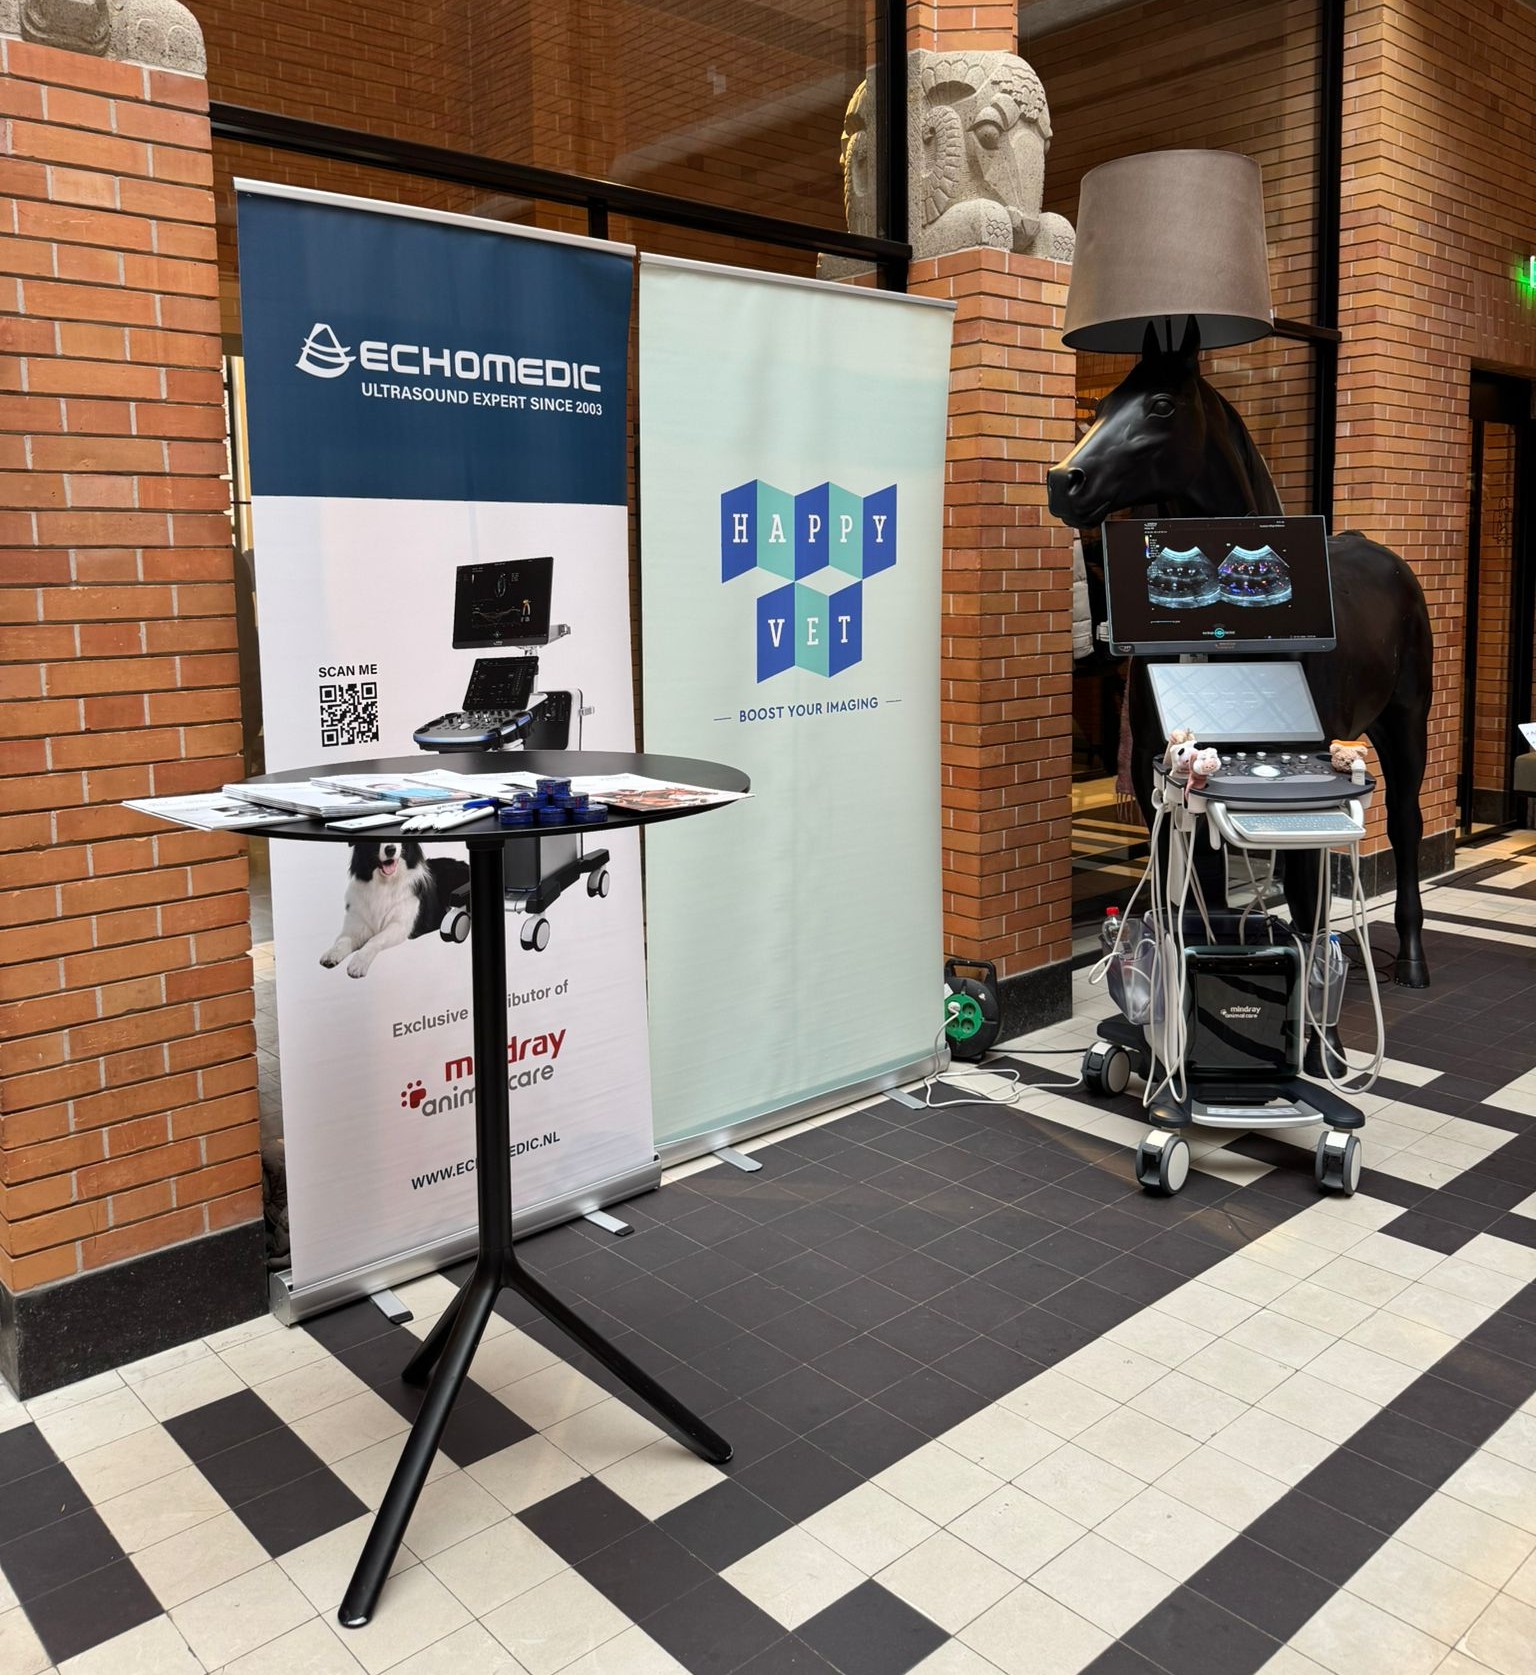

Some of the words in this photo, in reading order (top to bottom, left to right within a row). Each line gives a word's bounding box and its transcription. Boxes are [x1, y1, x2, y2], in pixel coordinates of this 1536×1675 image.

[360, 341, 602, 393] ECHOMEDIC
[361, 382, 469, 405] ULTRASOUND
[473, 392, 527, 409] EXPERT
[530, 397, 573, 413] SINCE
[576, 401, 602, 415] 2003
[733, 513, 887, 543] HAPPY
[768, 615, 850, 647] VET
[318, 665, 355, 678] SCAN
[359, 663, 378, 676] ME
[739, 706, 784, 722] BOOST
[788, 702, 823, 717] YOUR
[826, 697, 879, 712] IMAGING
[392, 1008, 469, 1038] Exclusive
[507, 986, 551, 1008] ibutor
[554, 979, 569, 996] of
[1230, 1005, 1261, 1014] mindray
[445, 1029, 567, 1082] mdray
[411, 1131, 561, 1190] WWW.ECEDIC.NL
